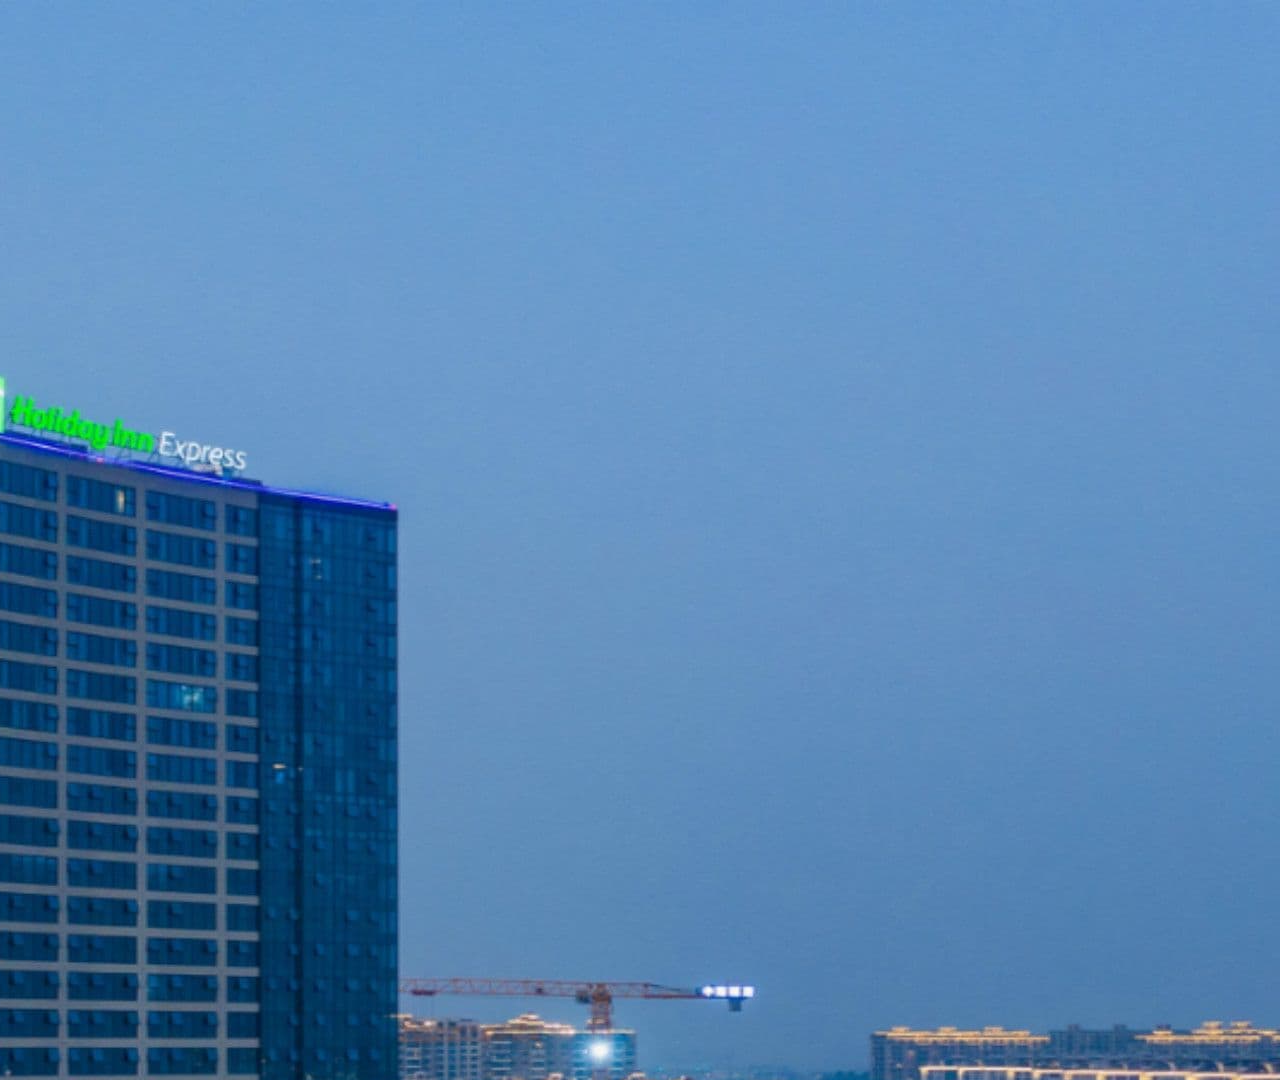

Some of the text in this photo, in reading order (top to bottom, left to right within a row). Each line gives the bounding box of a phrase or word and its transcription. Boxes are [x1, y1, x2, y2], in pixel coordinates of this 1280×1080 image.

[11, 395, 247, 470] Holiday Inn Express
